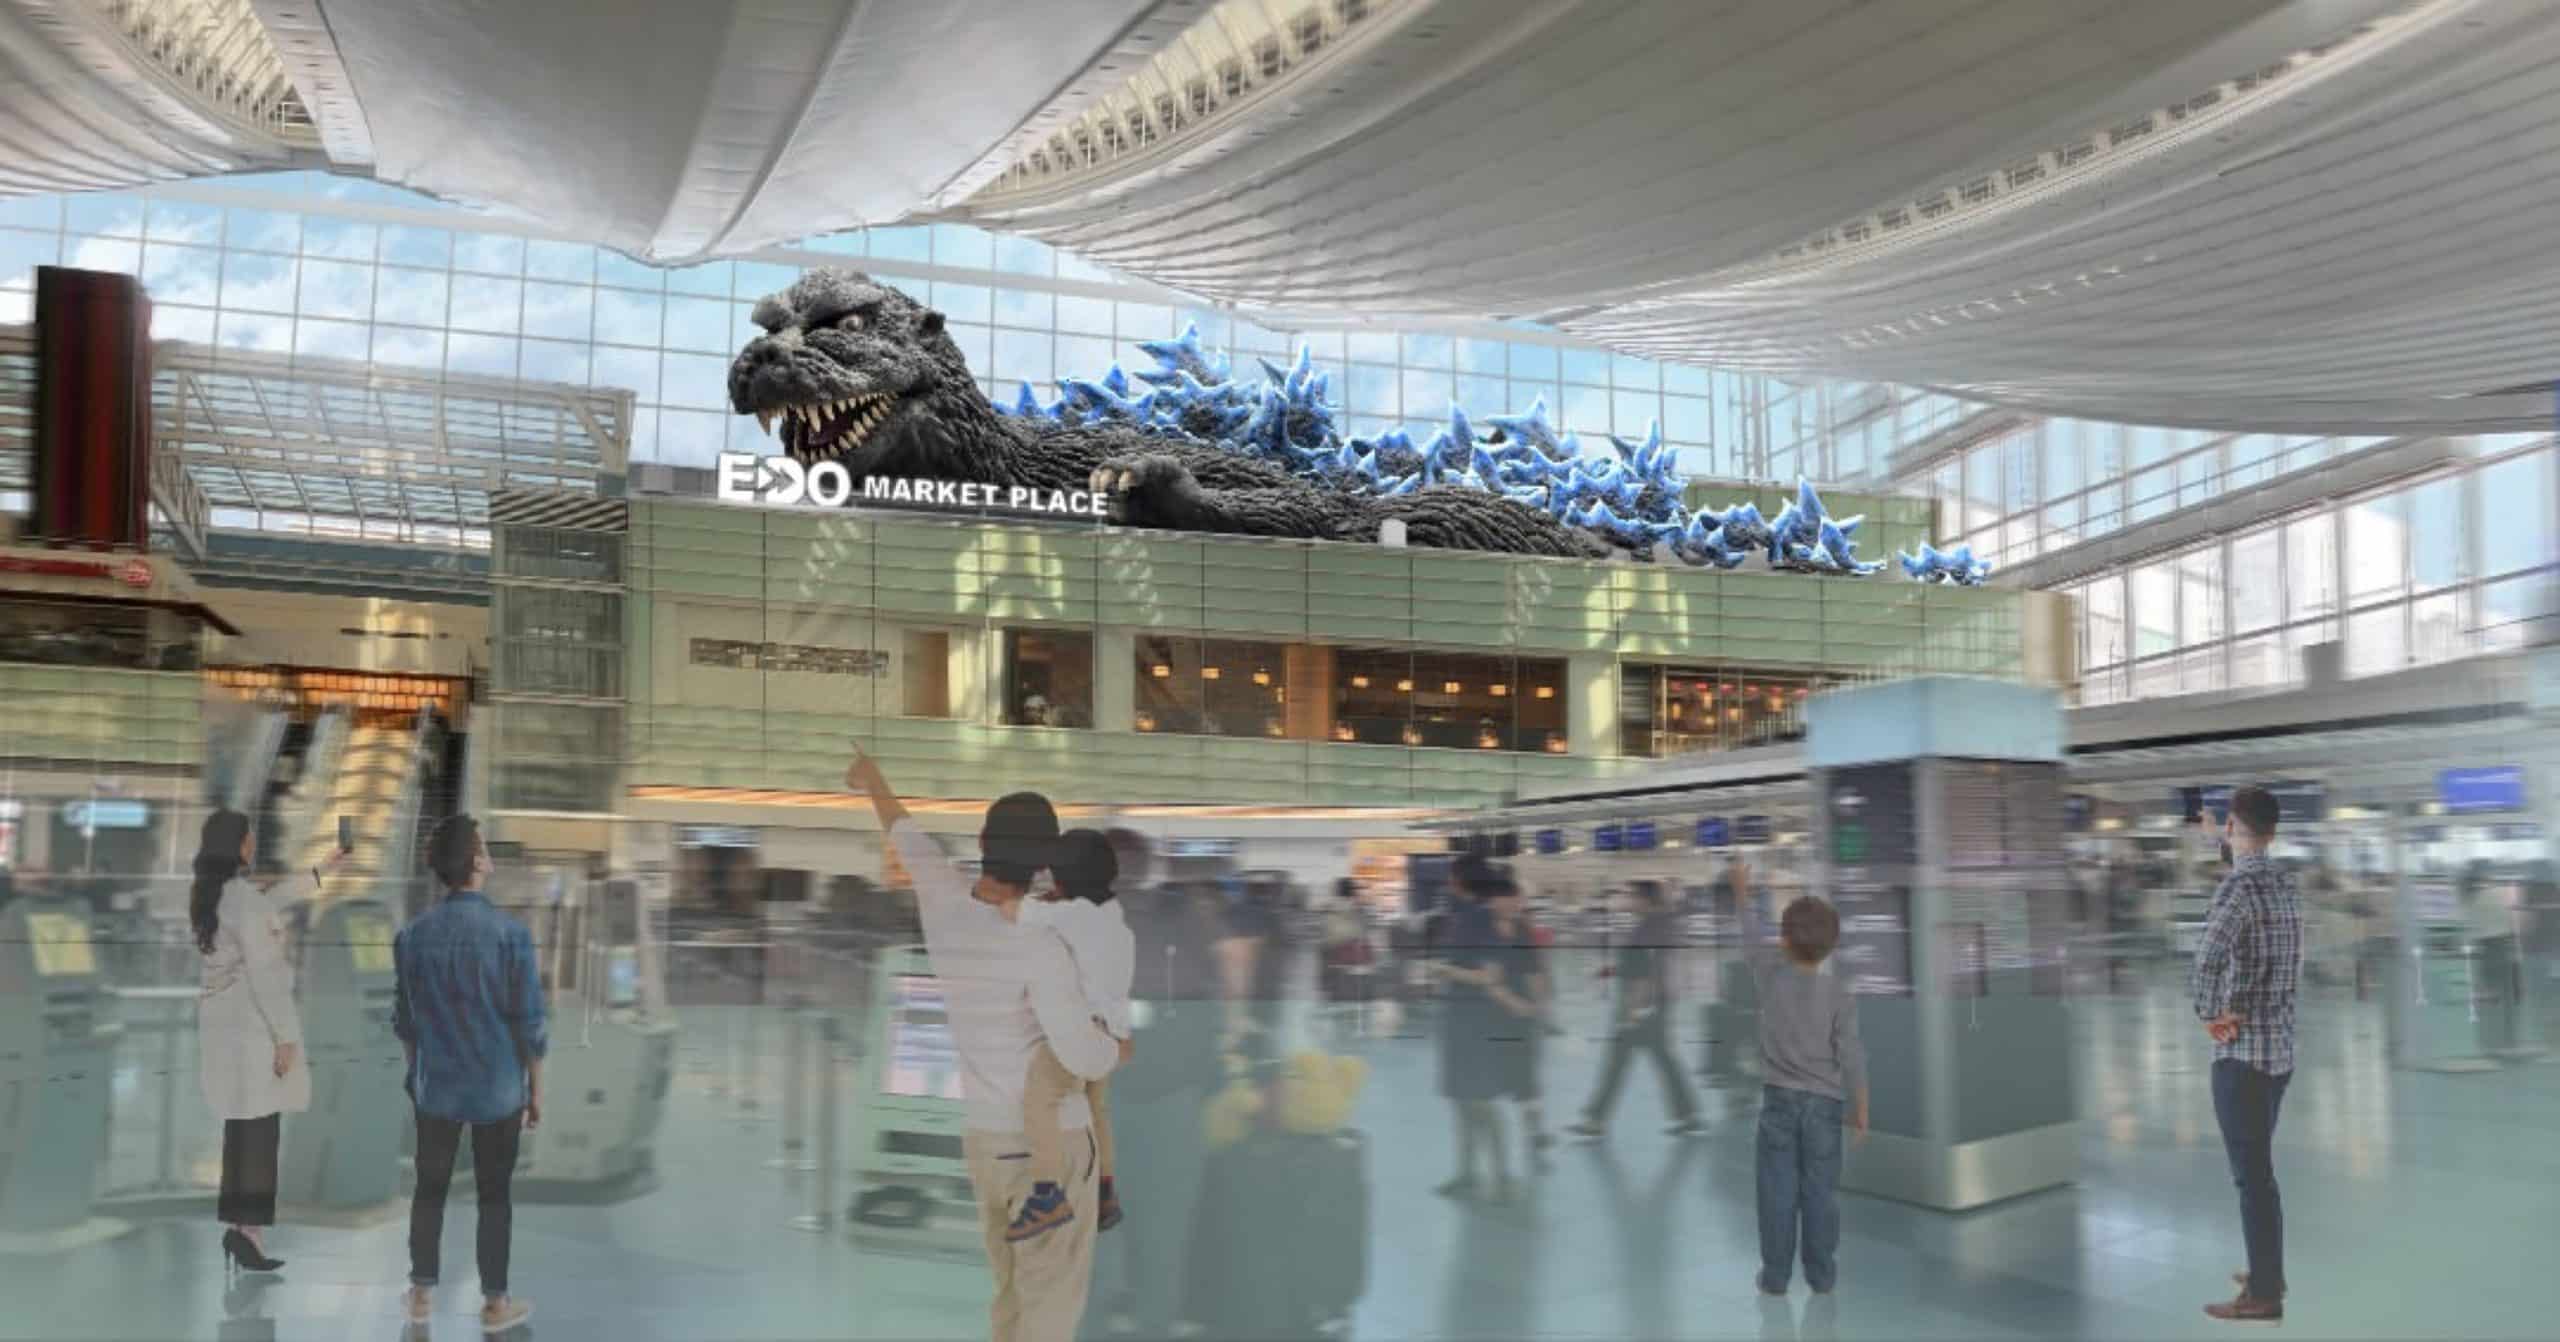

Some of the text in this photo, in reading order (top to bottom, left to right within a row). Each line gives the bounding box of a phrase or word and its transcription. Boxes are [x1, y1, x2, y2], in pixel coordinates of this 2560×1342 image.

[718, 453, 1109, 515] EDO MARKET PLACE
